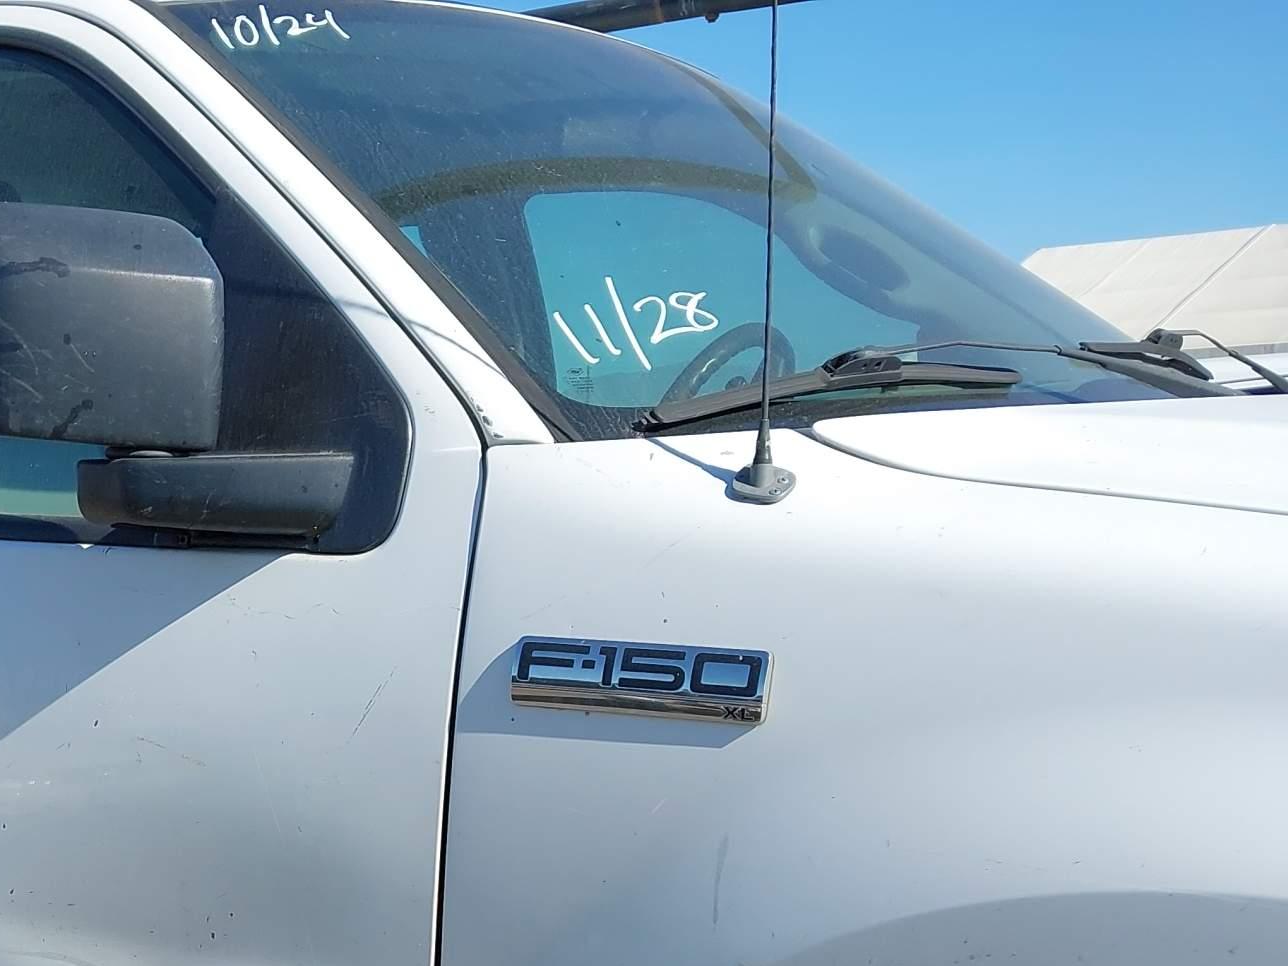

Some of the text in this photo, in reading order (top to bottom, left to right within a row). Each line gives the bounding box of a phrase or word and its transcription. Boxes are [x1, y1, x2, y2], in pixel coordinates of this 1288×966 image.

[210, 4, 351, 50] 10/24
[552, 275, 720, 371] 11/28
[516, 640, 764, 699] F-150
